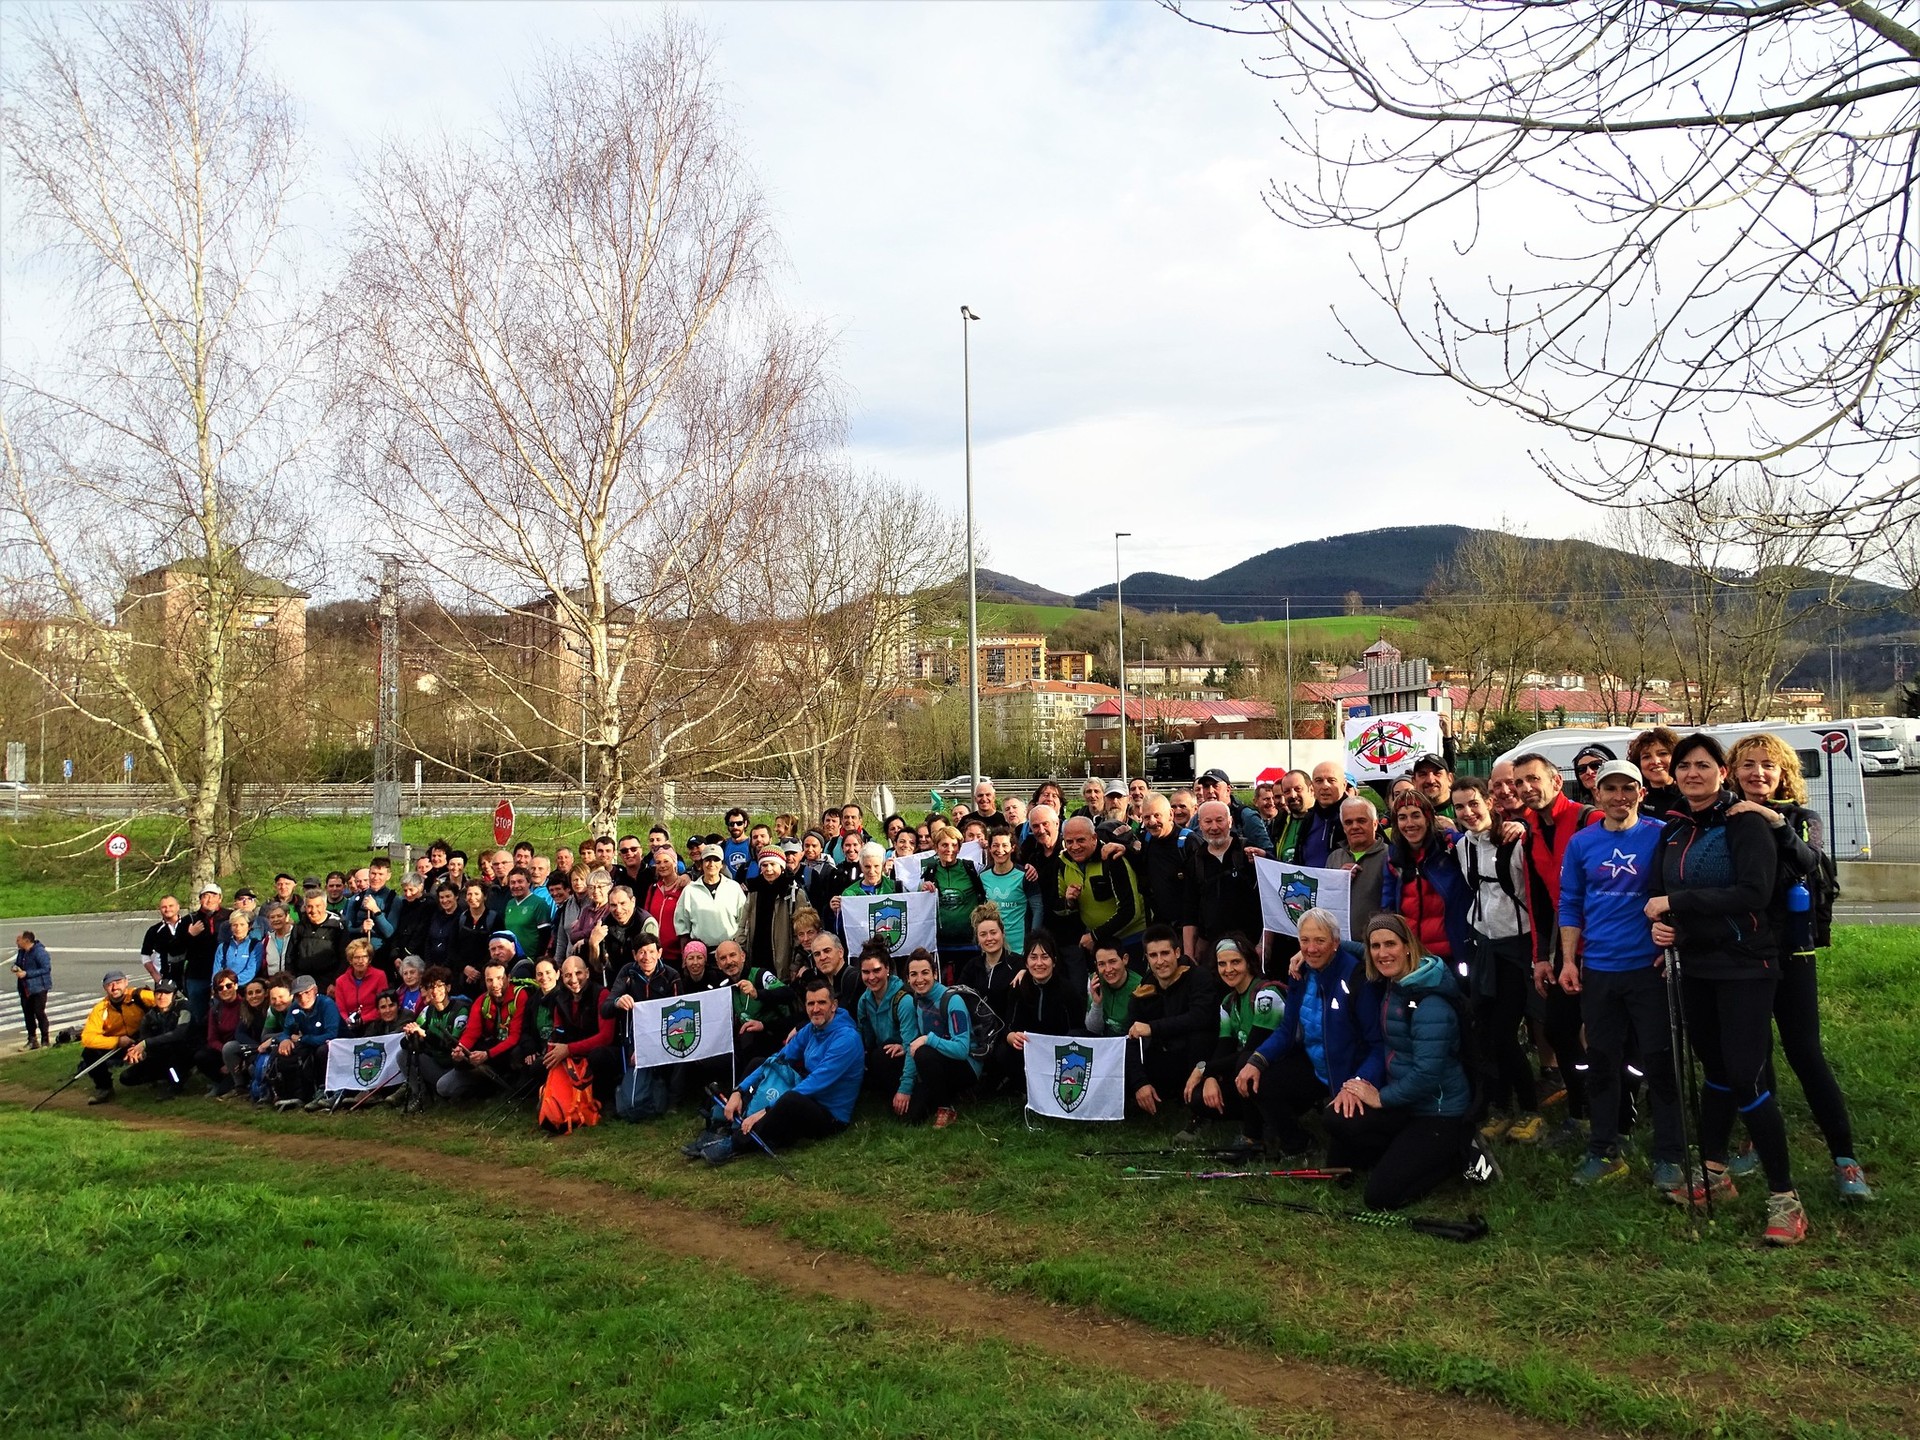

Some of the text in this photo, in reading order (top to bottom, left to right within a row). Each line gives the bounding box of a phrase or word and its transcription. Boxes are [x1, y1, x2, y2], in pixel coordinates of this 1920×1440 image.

[1379, 757, 1388, 765] EZ
[495, 816, 512, 829] STOP
[111, 841, 126, 850] 40
